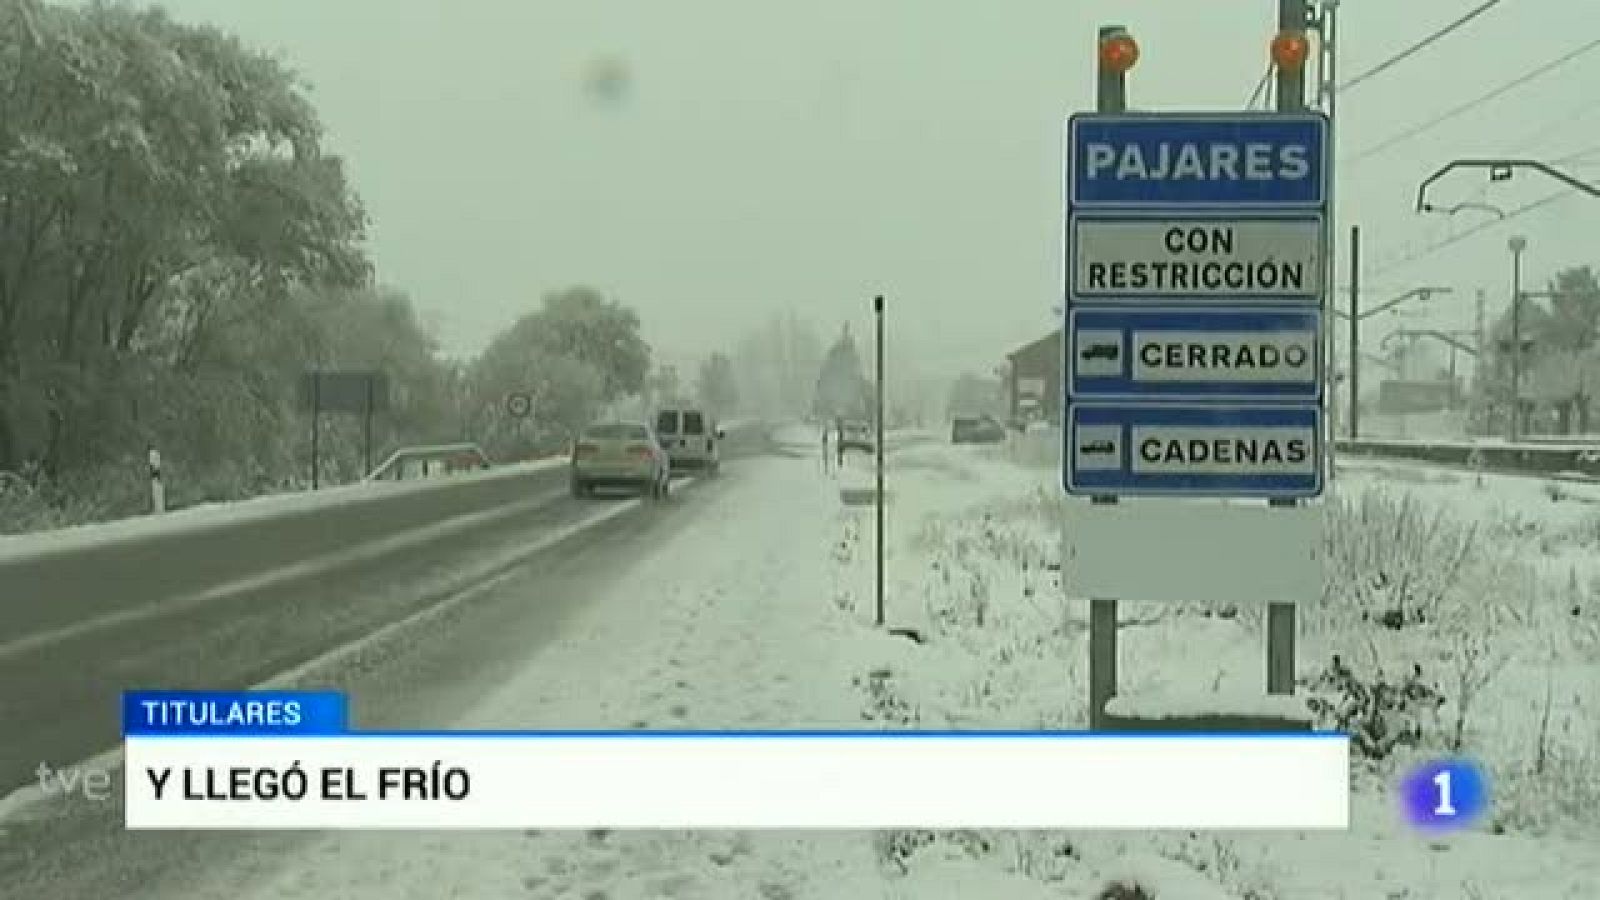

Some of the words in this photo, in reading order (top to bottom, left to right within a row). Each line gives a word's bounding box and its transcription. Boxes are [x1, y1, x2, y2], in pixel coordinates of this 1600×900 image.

[1086, 142, 1310, 181] PAJARES
[1164, 226, 1234, 254] CON
[1088, 256, 1304, 290] RESTRICCIÓN
[1140, 342, 1308, 368] CERRADO
[1140, 437, 1306, 463] CADENAS
